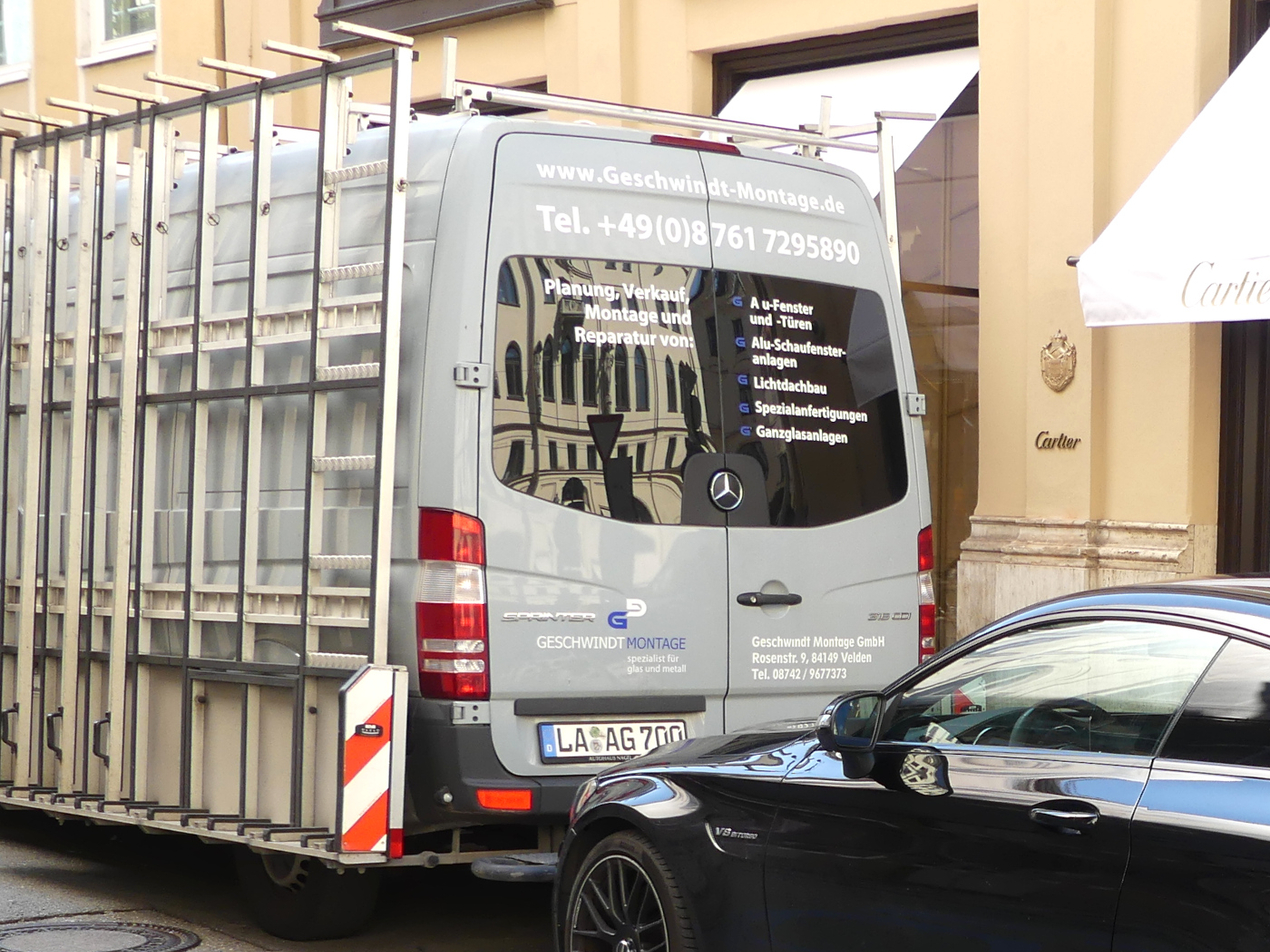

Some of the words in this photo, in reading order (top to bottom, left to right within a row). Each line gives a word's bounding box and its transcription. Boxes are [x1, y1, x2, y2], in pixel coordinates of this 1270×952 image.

[536, 163, 845, 215] www.Geschwindt-Montage.de
[536, 204, 590, 235] Tel.
[762, 228, 861, 266] 7295890
[543, 278, 620, 302] Planung,
[622, 282, 690, 305] Verkauf,
[584, 304, 658, 326] Montage
[661, 309, 692, 326] und
[750, 313, 773, 326] und
[776, 315, 813, 331] -Türen
[574, 326, 657, 347] Reparatur
[659, 334, 694, 348] von:
[751, 336, 847, 358] Alu-Schaufenster-
[752, 353, 798, 370] anlagen
[753, 376, 828, 395] Lichtdachbau
[755, 400, 868, 424] Spezialanfertigungen
[756, 425, 848, 446] Ganzglasanlagen
[1034, 430, 1081, 450] Cartier
[501, 611, 596, 622] SPRINTER
[892, 612, 912, 621] CDI
[536, 636, 625, 649] GESCHWINDT
[627, 637, 686, 650] MONTAGE
[752, 636, 811, 648] Geschwindt
[813, 636, 855, 649] Montage
[857, 635, 885, 647] GmbH
[627, 654, 665, 664] spezialist
[667, 654, 679, 663] für
[752, 652, 798, 664] Rosenstr.
[801, 652, 809, 665] 9,
[812, 652, 838, 663] 84149
[841, 652, 872, 663] Velden
[627, 664, 643, 674] glas
[645, 664, 660, 673] und
[662, 664, 687, 673] metall
[752, 668, 770, 680] Tel.
[772, 668, 801, 680] 08742
[809, 668, 847, 680] 9677373
[556, 728, 589, 753] LA
[606, 727, 636, 752] AG
